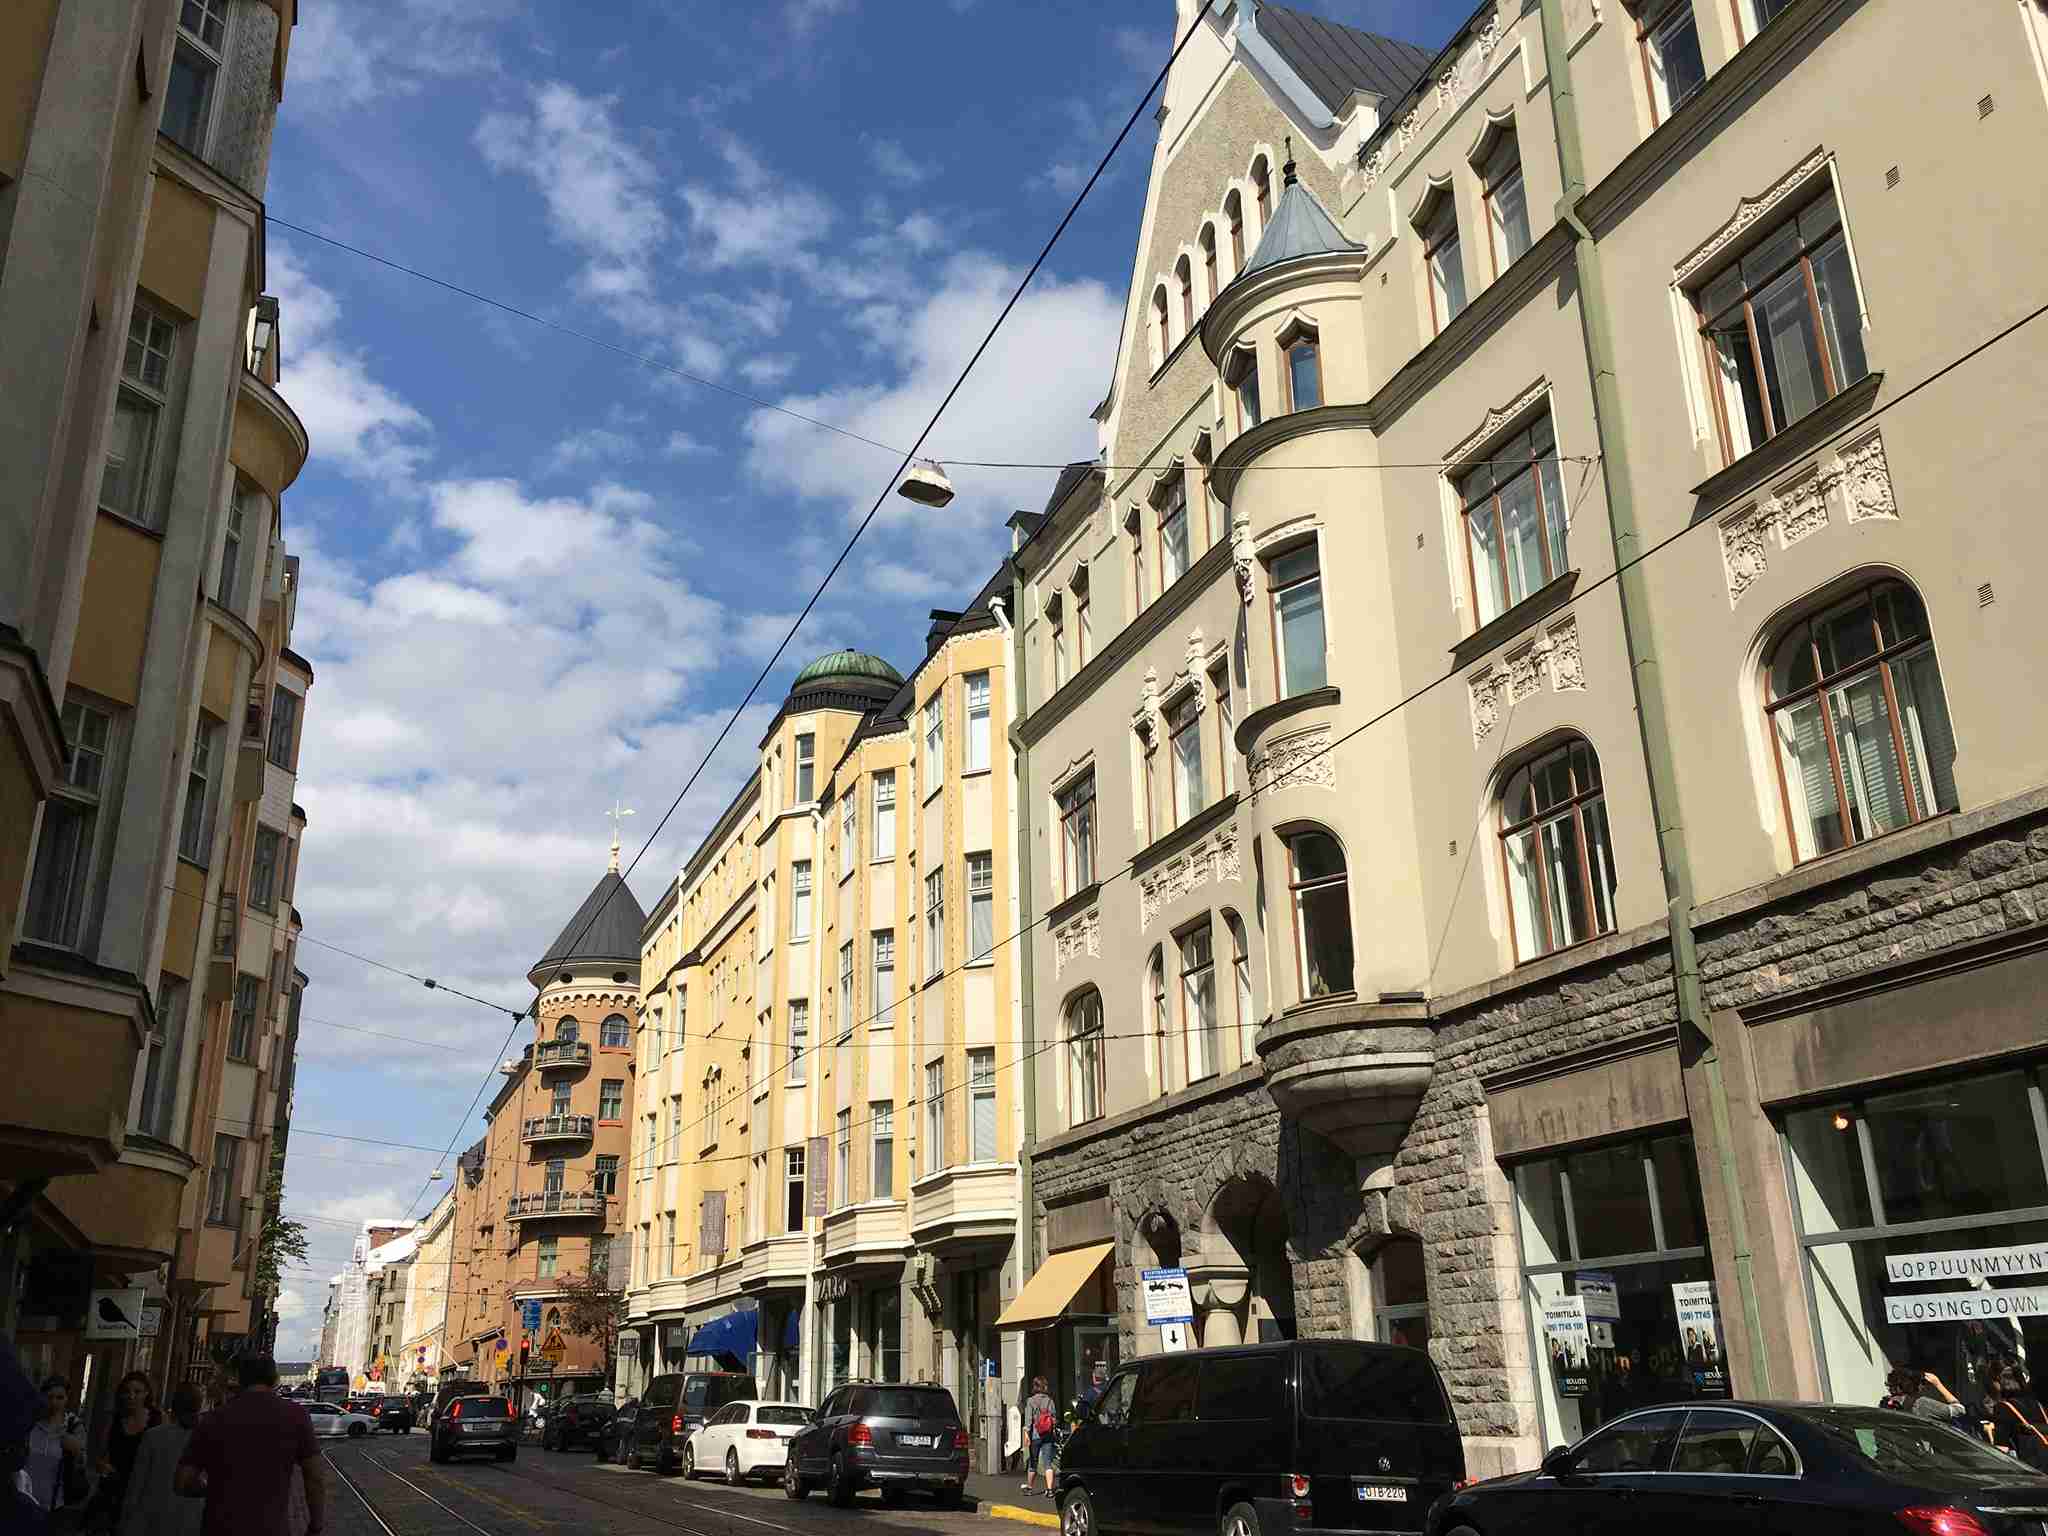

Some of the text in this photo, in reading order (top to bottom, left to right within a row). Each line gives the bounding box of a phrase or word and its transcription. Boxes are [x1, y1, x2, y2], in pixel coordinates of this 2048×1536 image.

[1891, 1251, 2048, 1279] LOPPUUNMYYN
[1679, 1297, 1714, 1307] TOIMITIL
[1891, 1295, 2040, 1320] CLOSING DOWN
